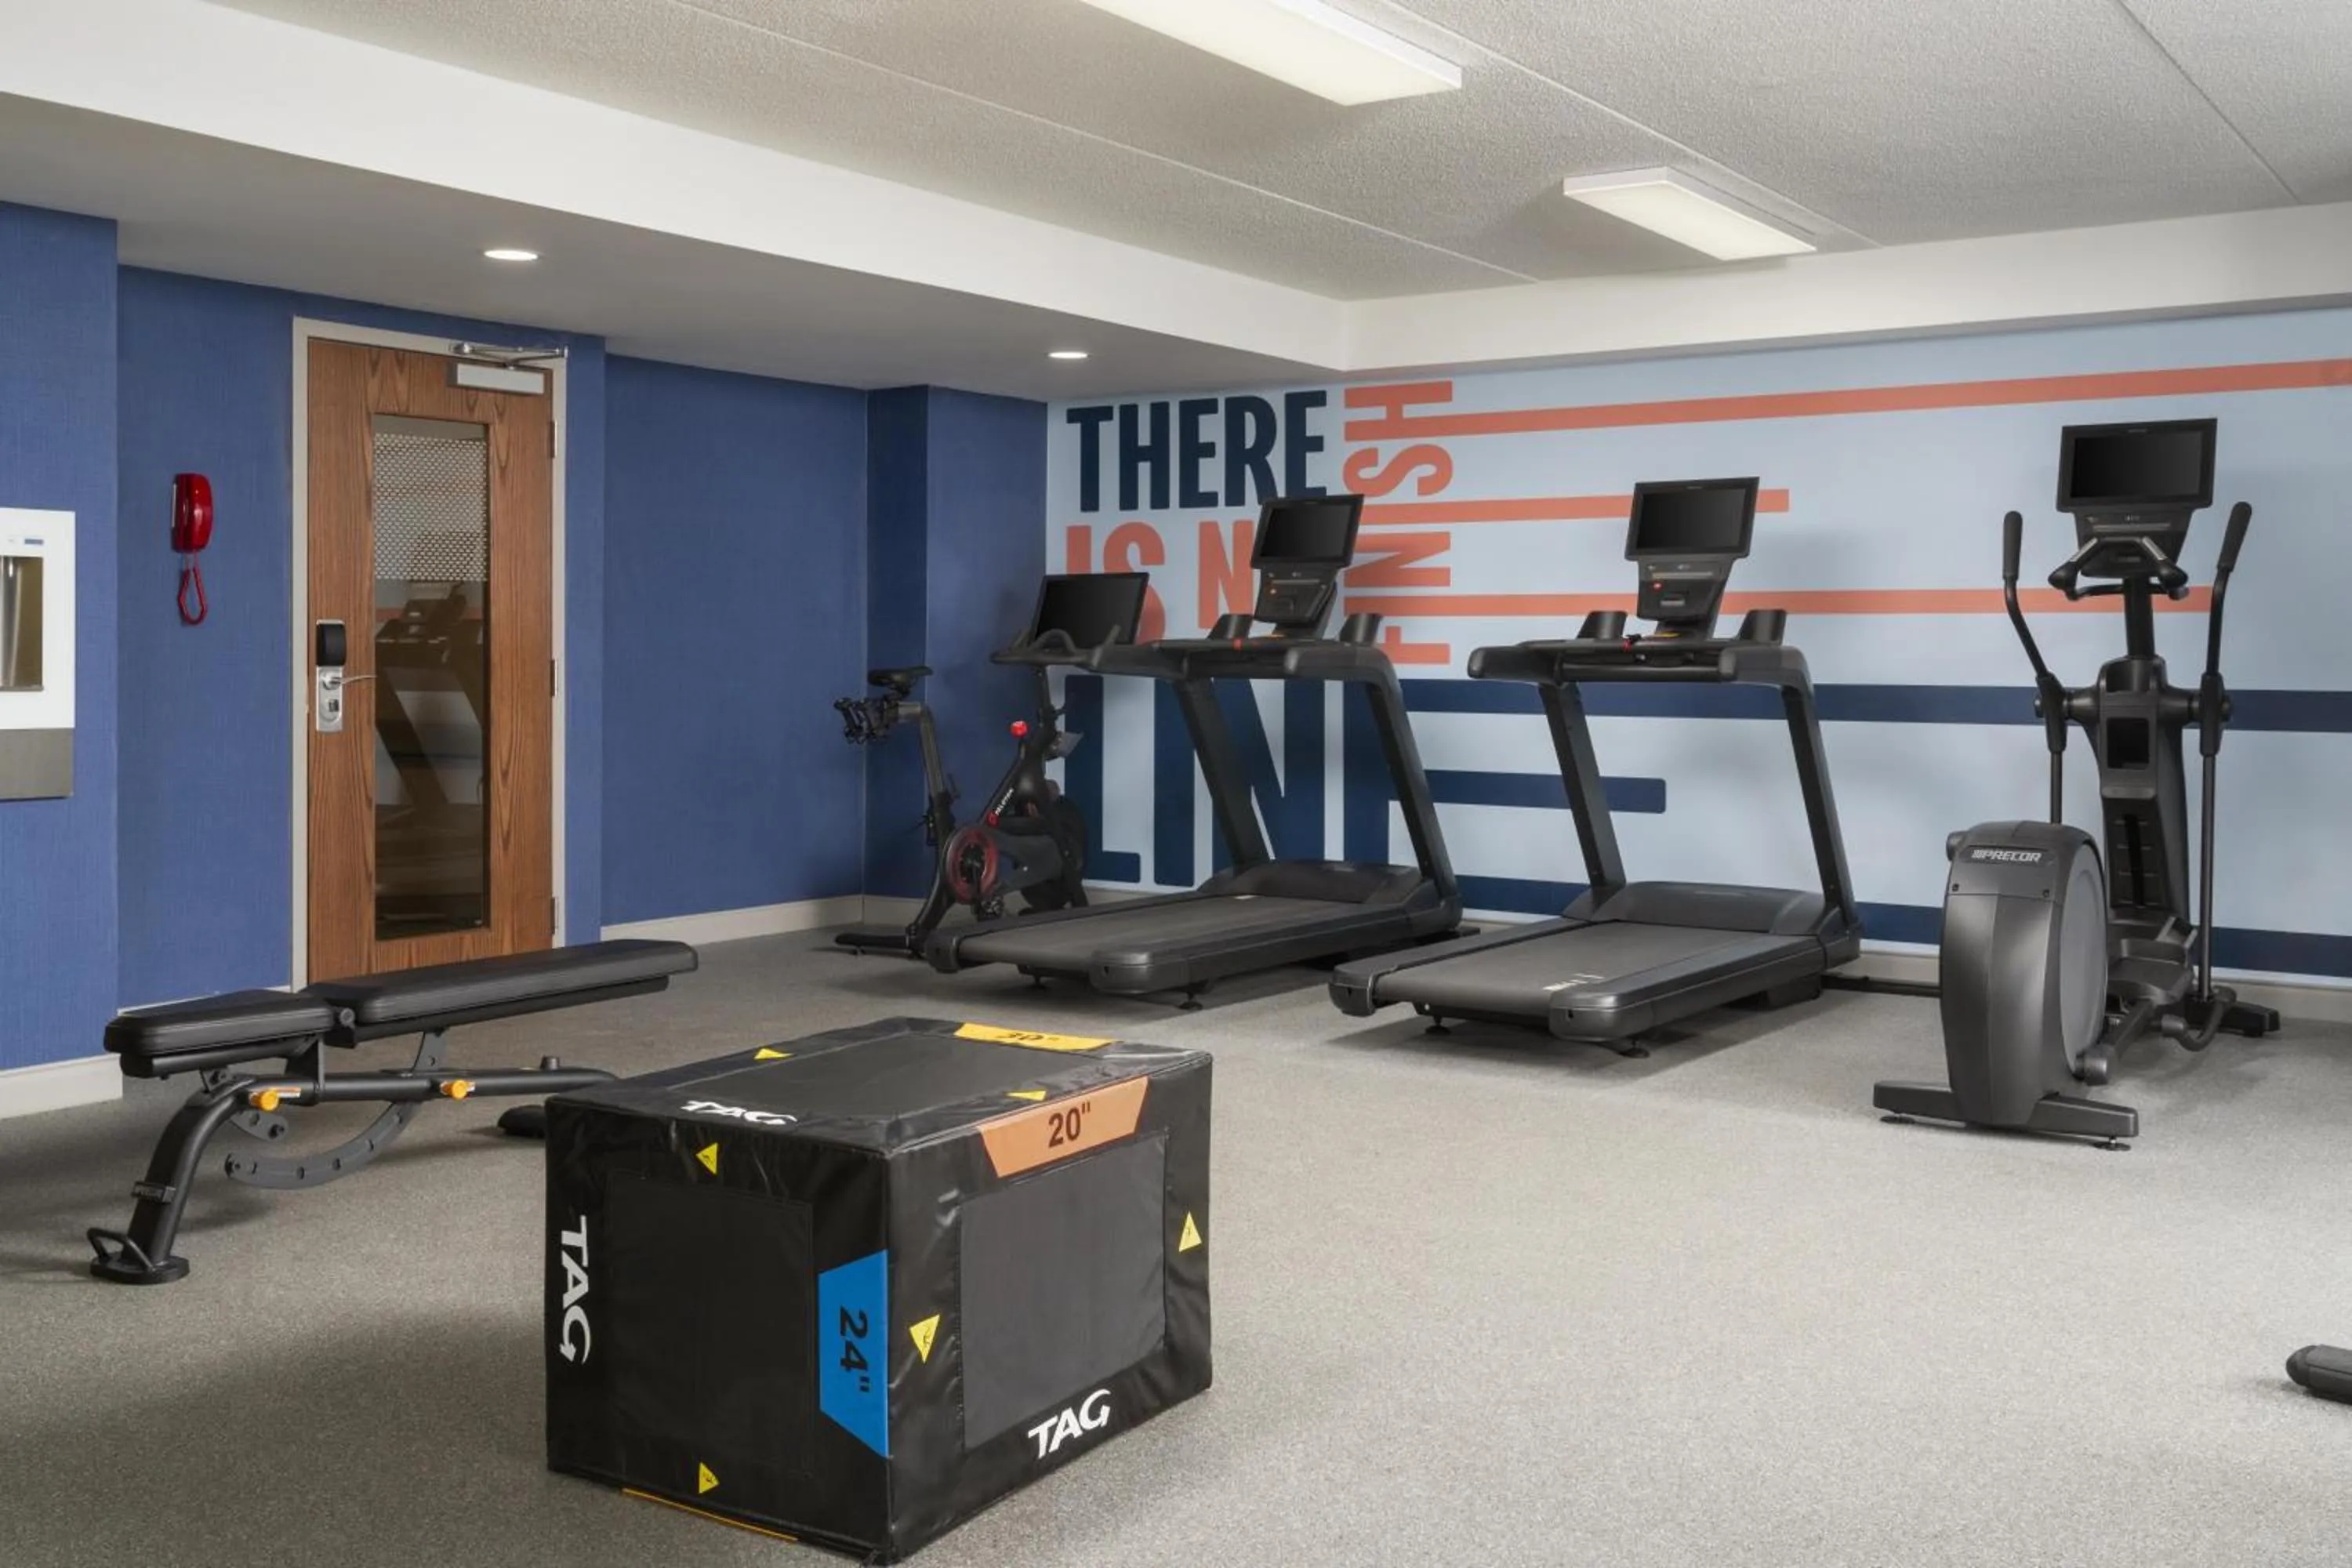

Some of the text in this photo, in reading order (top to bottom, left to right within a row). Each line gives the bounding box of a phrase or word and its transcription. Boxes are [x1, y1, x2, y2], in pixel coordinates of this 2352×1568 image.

[1066, 390, 1327, 512] THERE
[1342, 380, 1453, 665] FINISH
[1980, 850, 2042, 862] PRECOR
[1047, 1102, 1092, 1147] 20"
[559, 1216, 592, 1366] TAG
[839, 1306, 870, 1394] 24"
[1027, 1388, 1111, 1459] TAG
